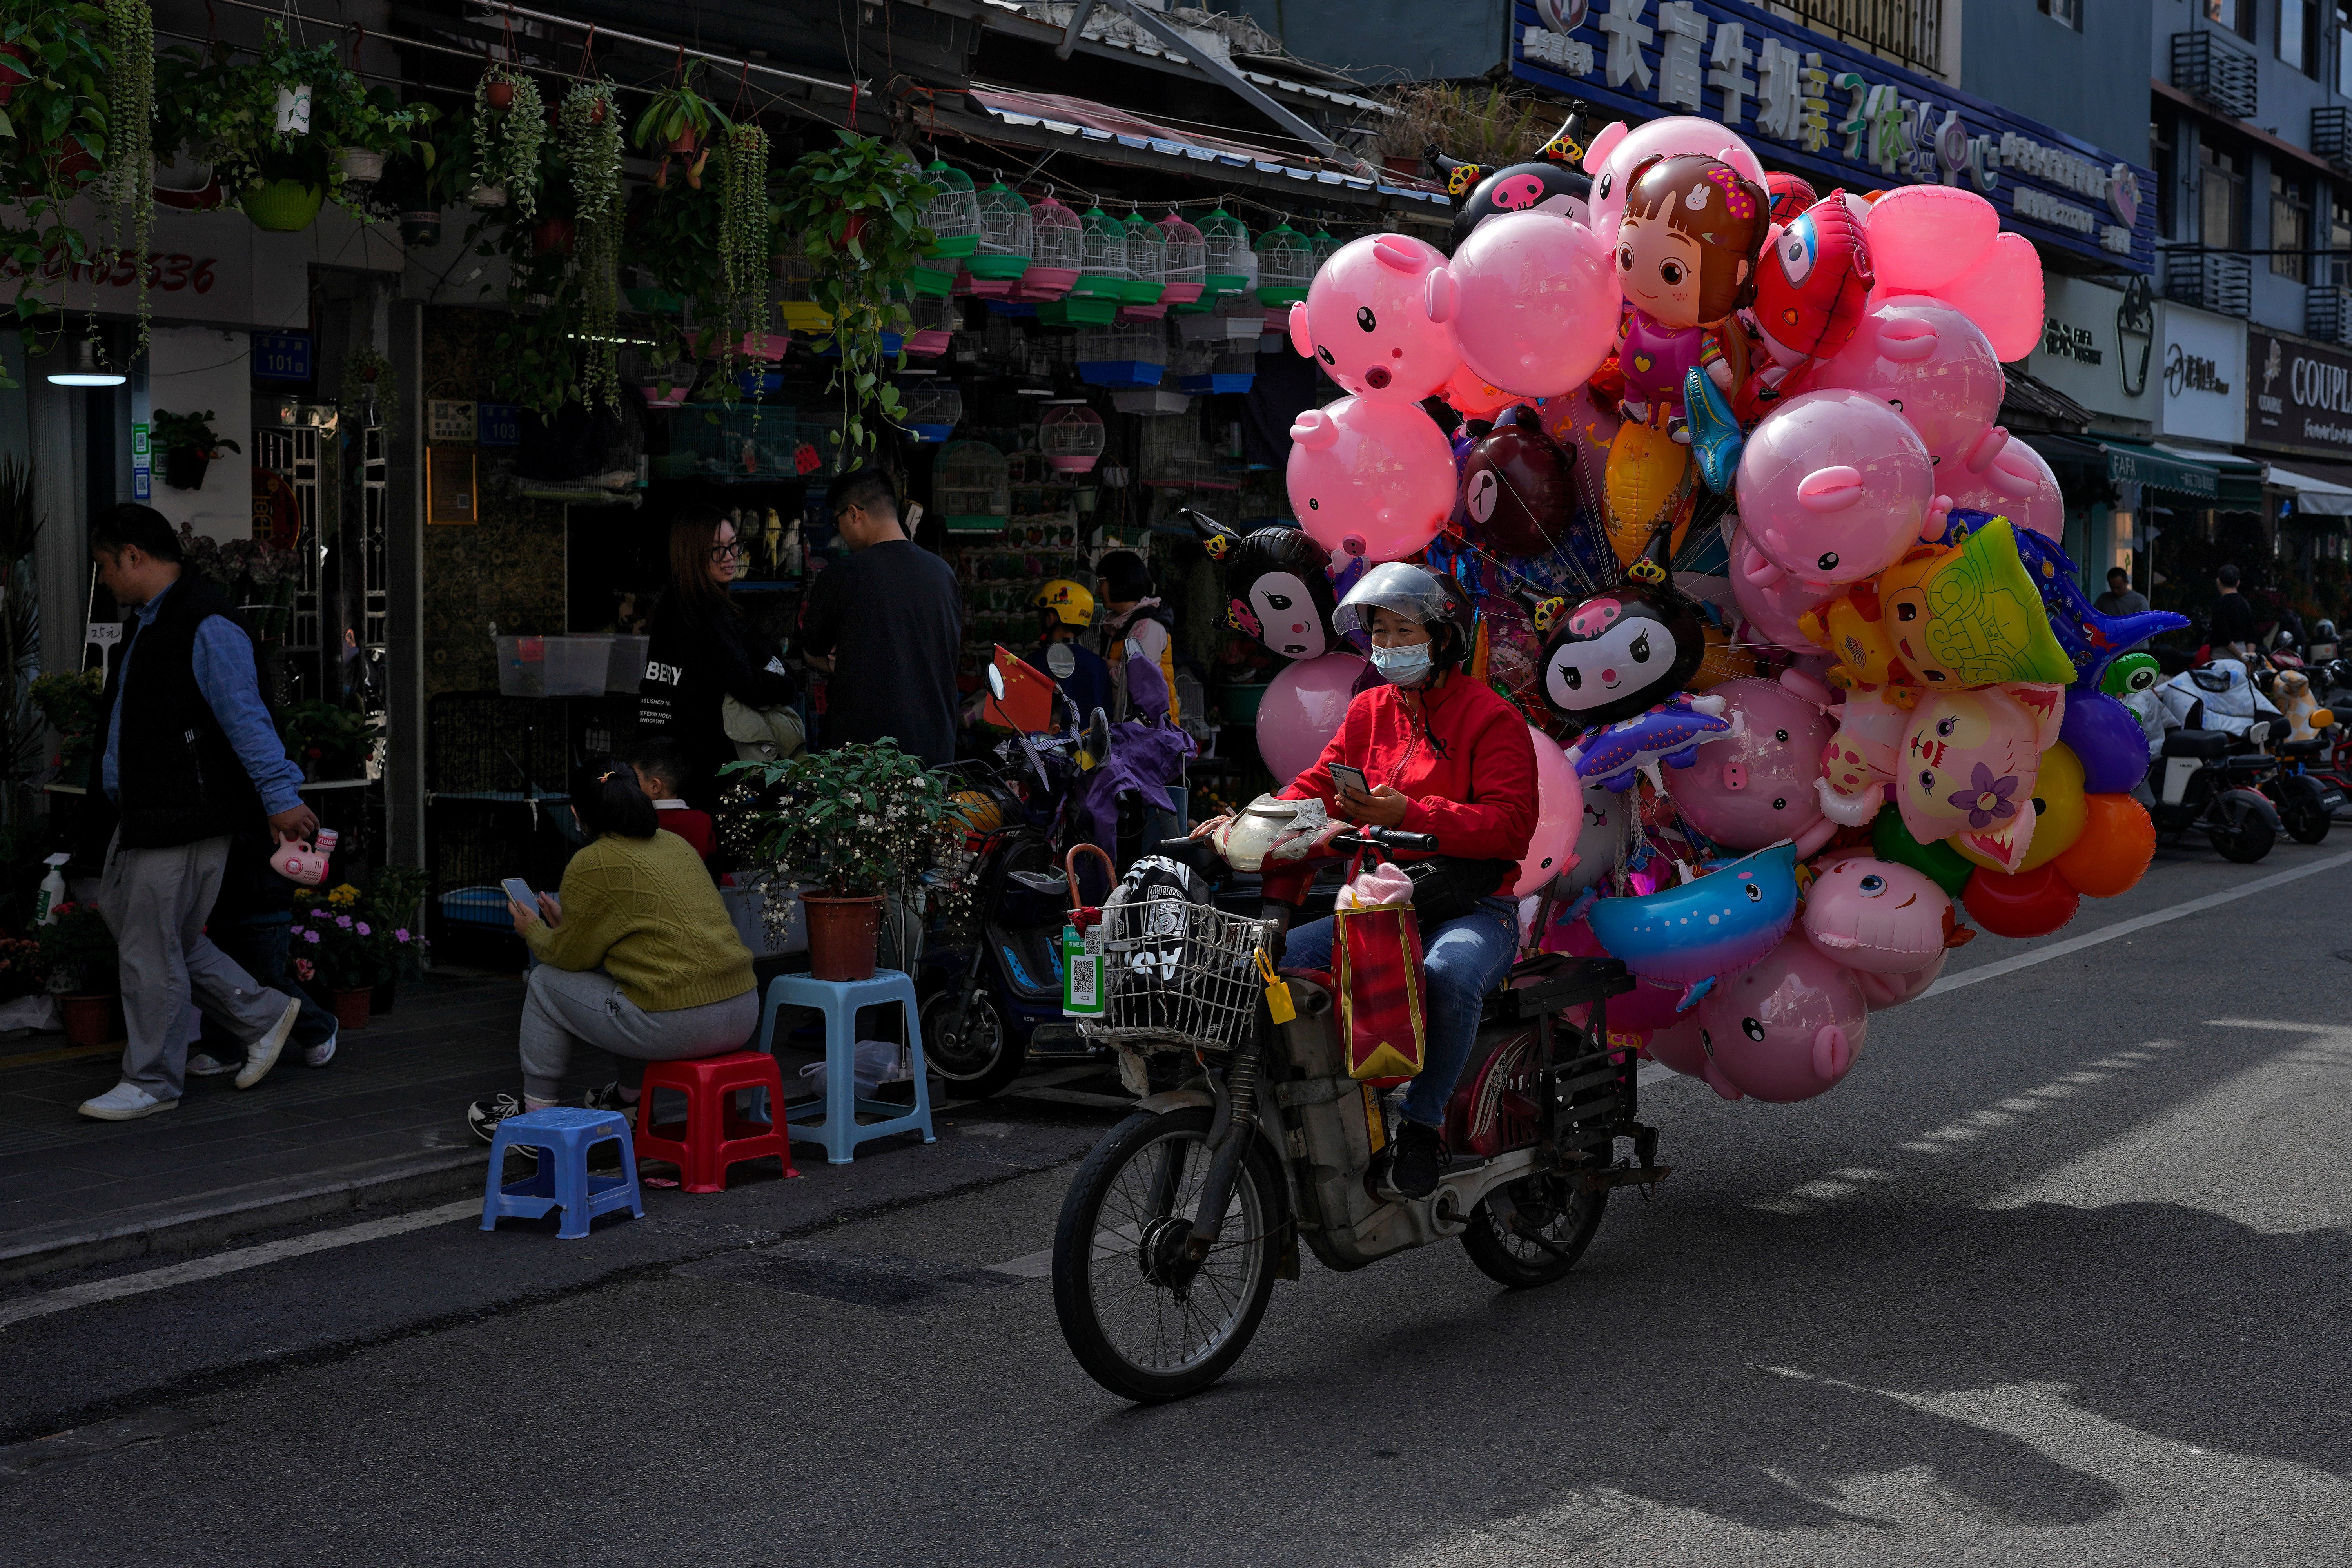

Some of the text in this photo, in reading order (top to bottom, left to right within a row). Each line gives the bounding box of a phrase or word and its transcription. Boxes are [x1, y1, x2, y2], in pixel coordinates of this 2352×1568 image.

[1523, 26, 1594, 76] 长富牛奶
[2291, 357, 2352, 416] COUPL
